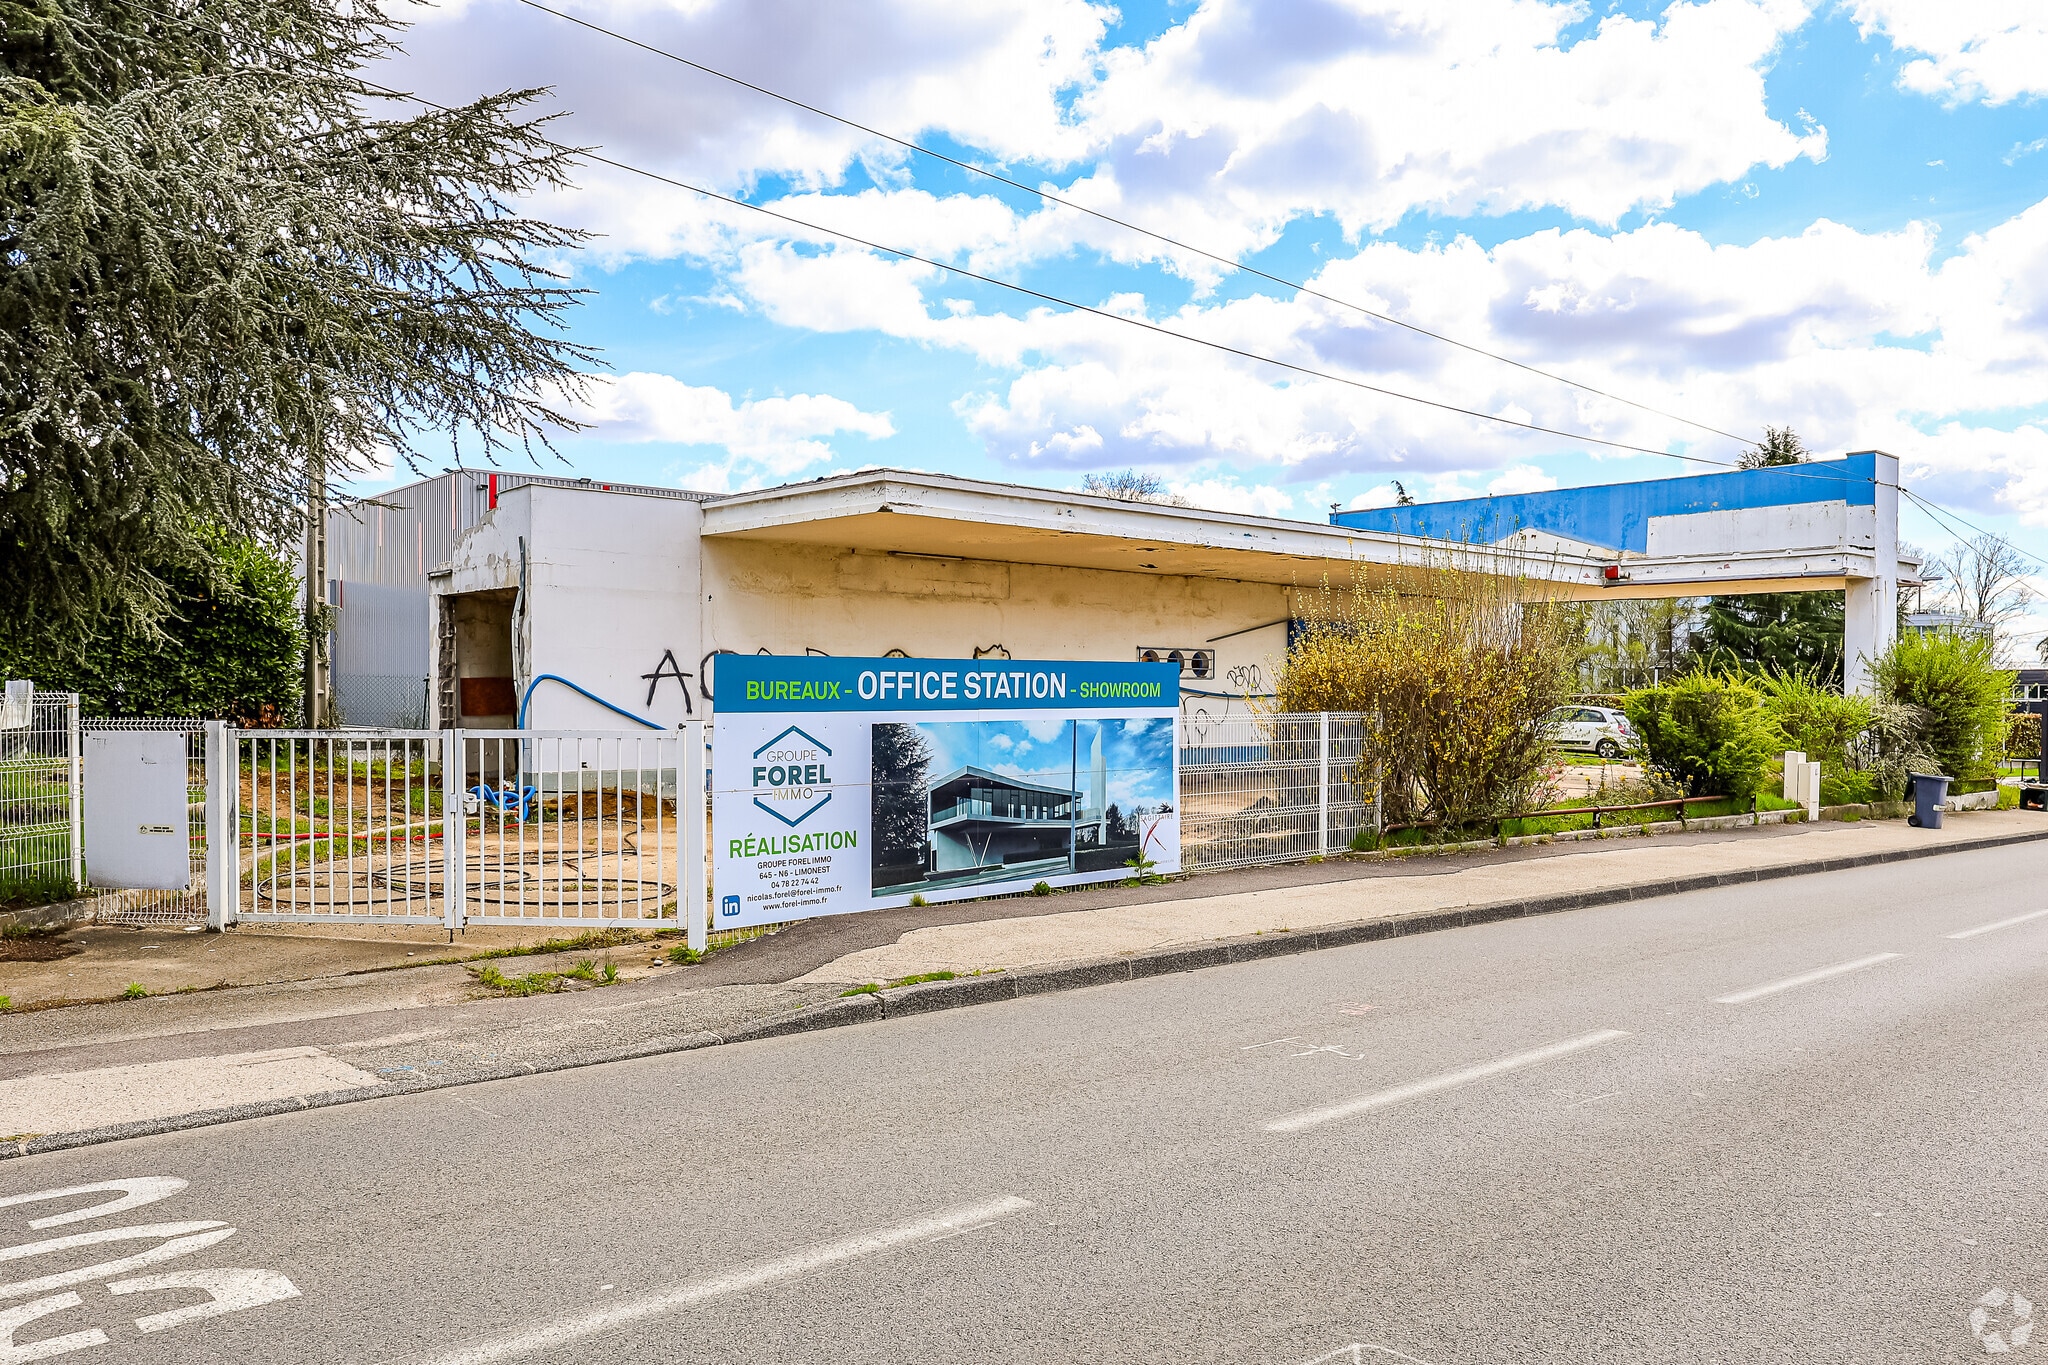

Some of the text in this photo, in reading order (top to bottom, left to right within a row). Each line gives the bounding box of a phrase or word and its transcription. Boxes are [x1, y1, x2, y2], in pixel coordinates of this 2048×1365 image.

[746, 680, 841, 700] BUREAUX
[857, 670, 958, 700] OFFICE
[964, 671, 1066, 699] STATION
[1080, 681, 1161, 698] SHOWROOM
[766, 750, 818, 762] GROUPE
[753, 764, 832, 787] FOREL
[773, 787, 813, 800] IMMO
[729, 830, 857, 859] RÉALISATION
[757, 855, 832, 869] GROUPE FOREL IMMO
[759, 871, 773, 880] 645
[794, 865, 830, 876] LIMONEST
[781, 880, 790, 888] 78
[791, 879, 800, 887] 22
[747, 885, 842, 902] nicolas.forel@forel-immo.fr
[763, 896, 828, 911] www.forel-immo.fr
